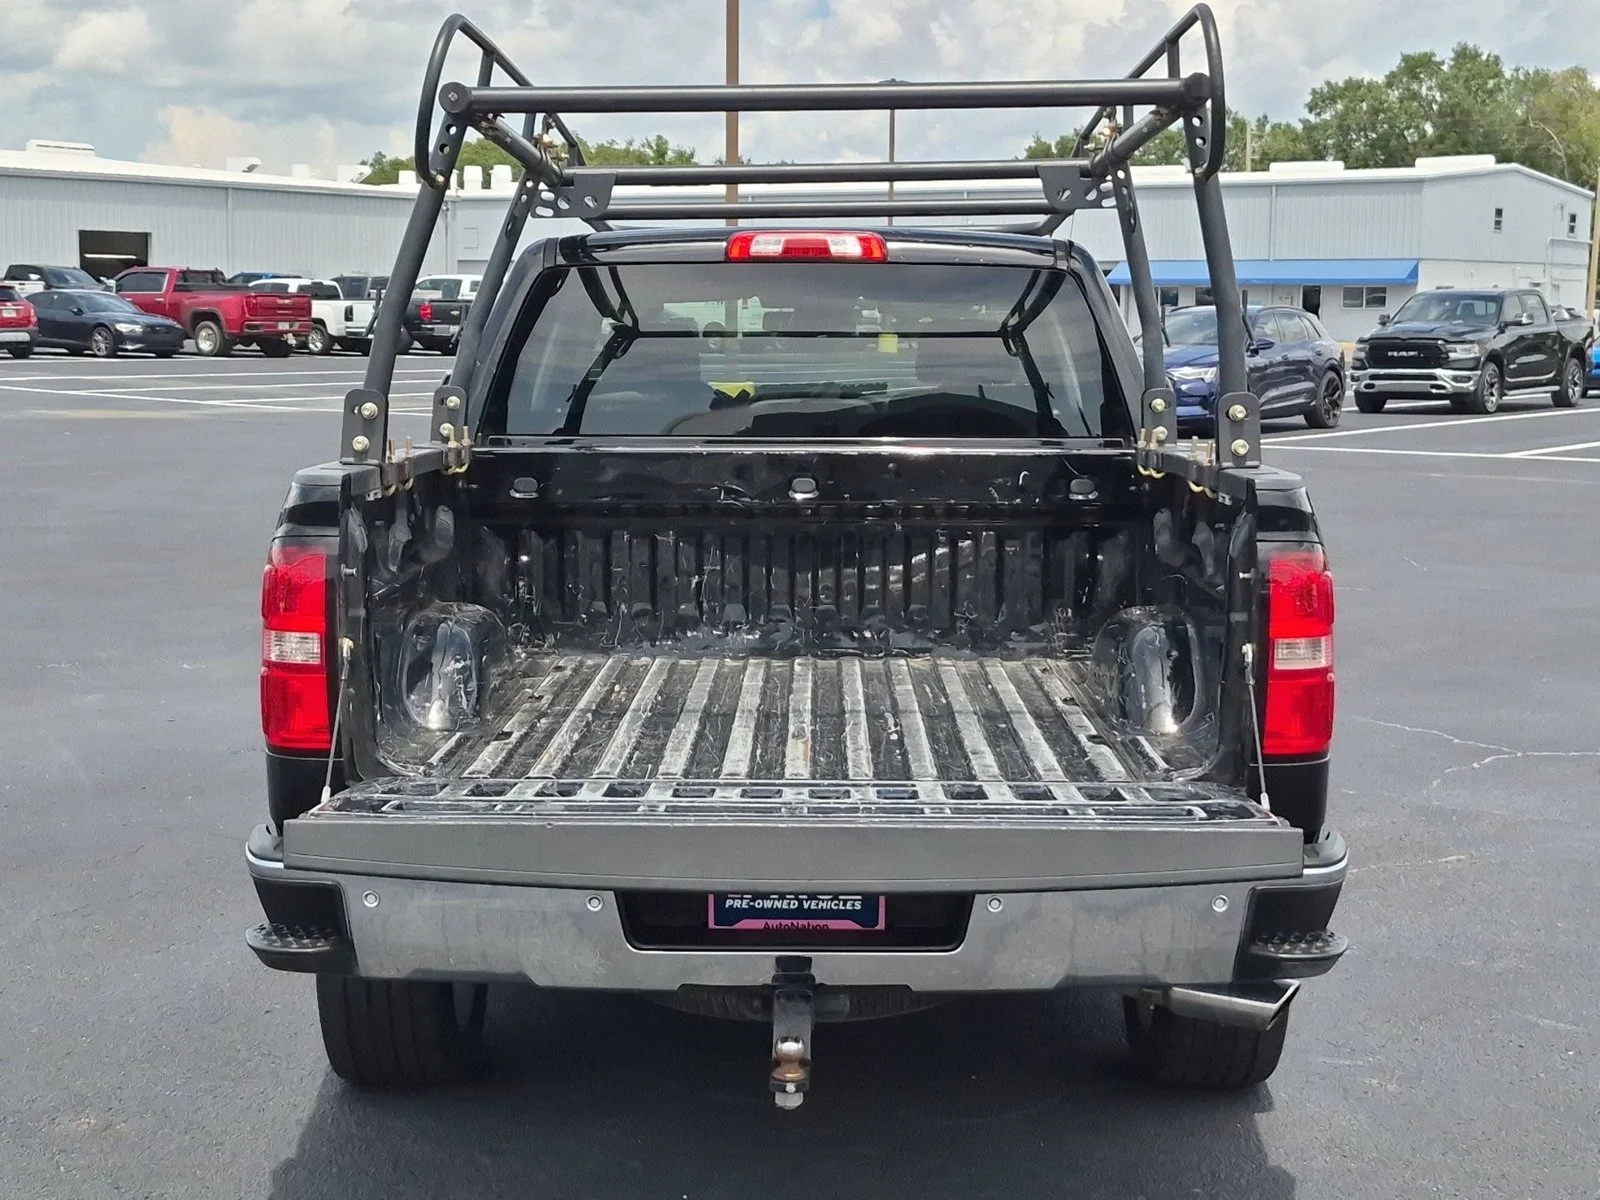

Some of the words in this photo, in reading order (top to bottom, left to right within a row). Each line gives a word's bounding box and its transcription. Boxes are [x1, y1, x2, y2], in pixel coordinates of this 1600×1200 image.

[725, 899, 799, 909] PRE-OWNED
[802, 899, 863, 910] VEHICLES
[762, 921, 830, 930] AutoNation
